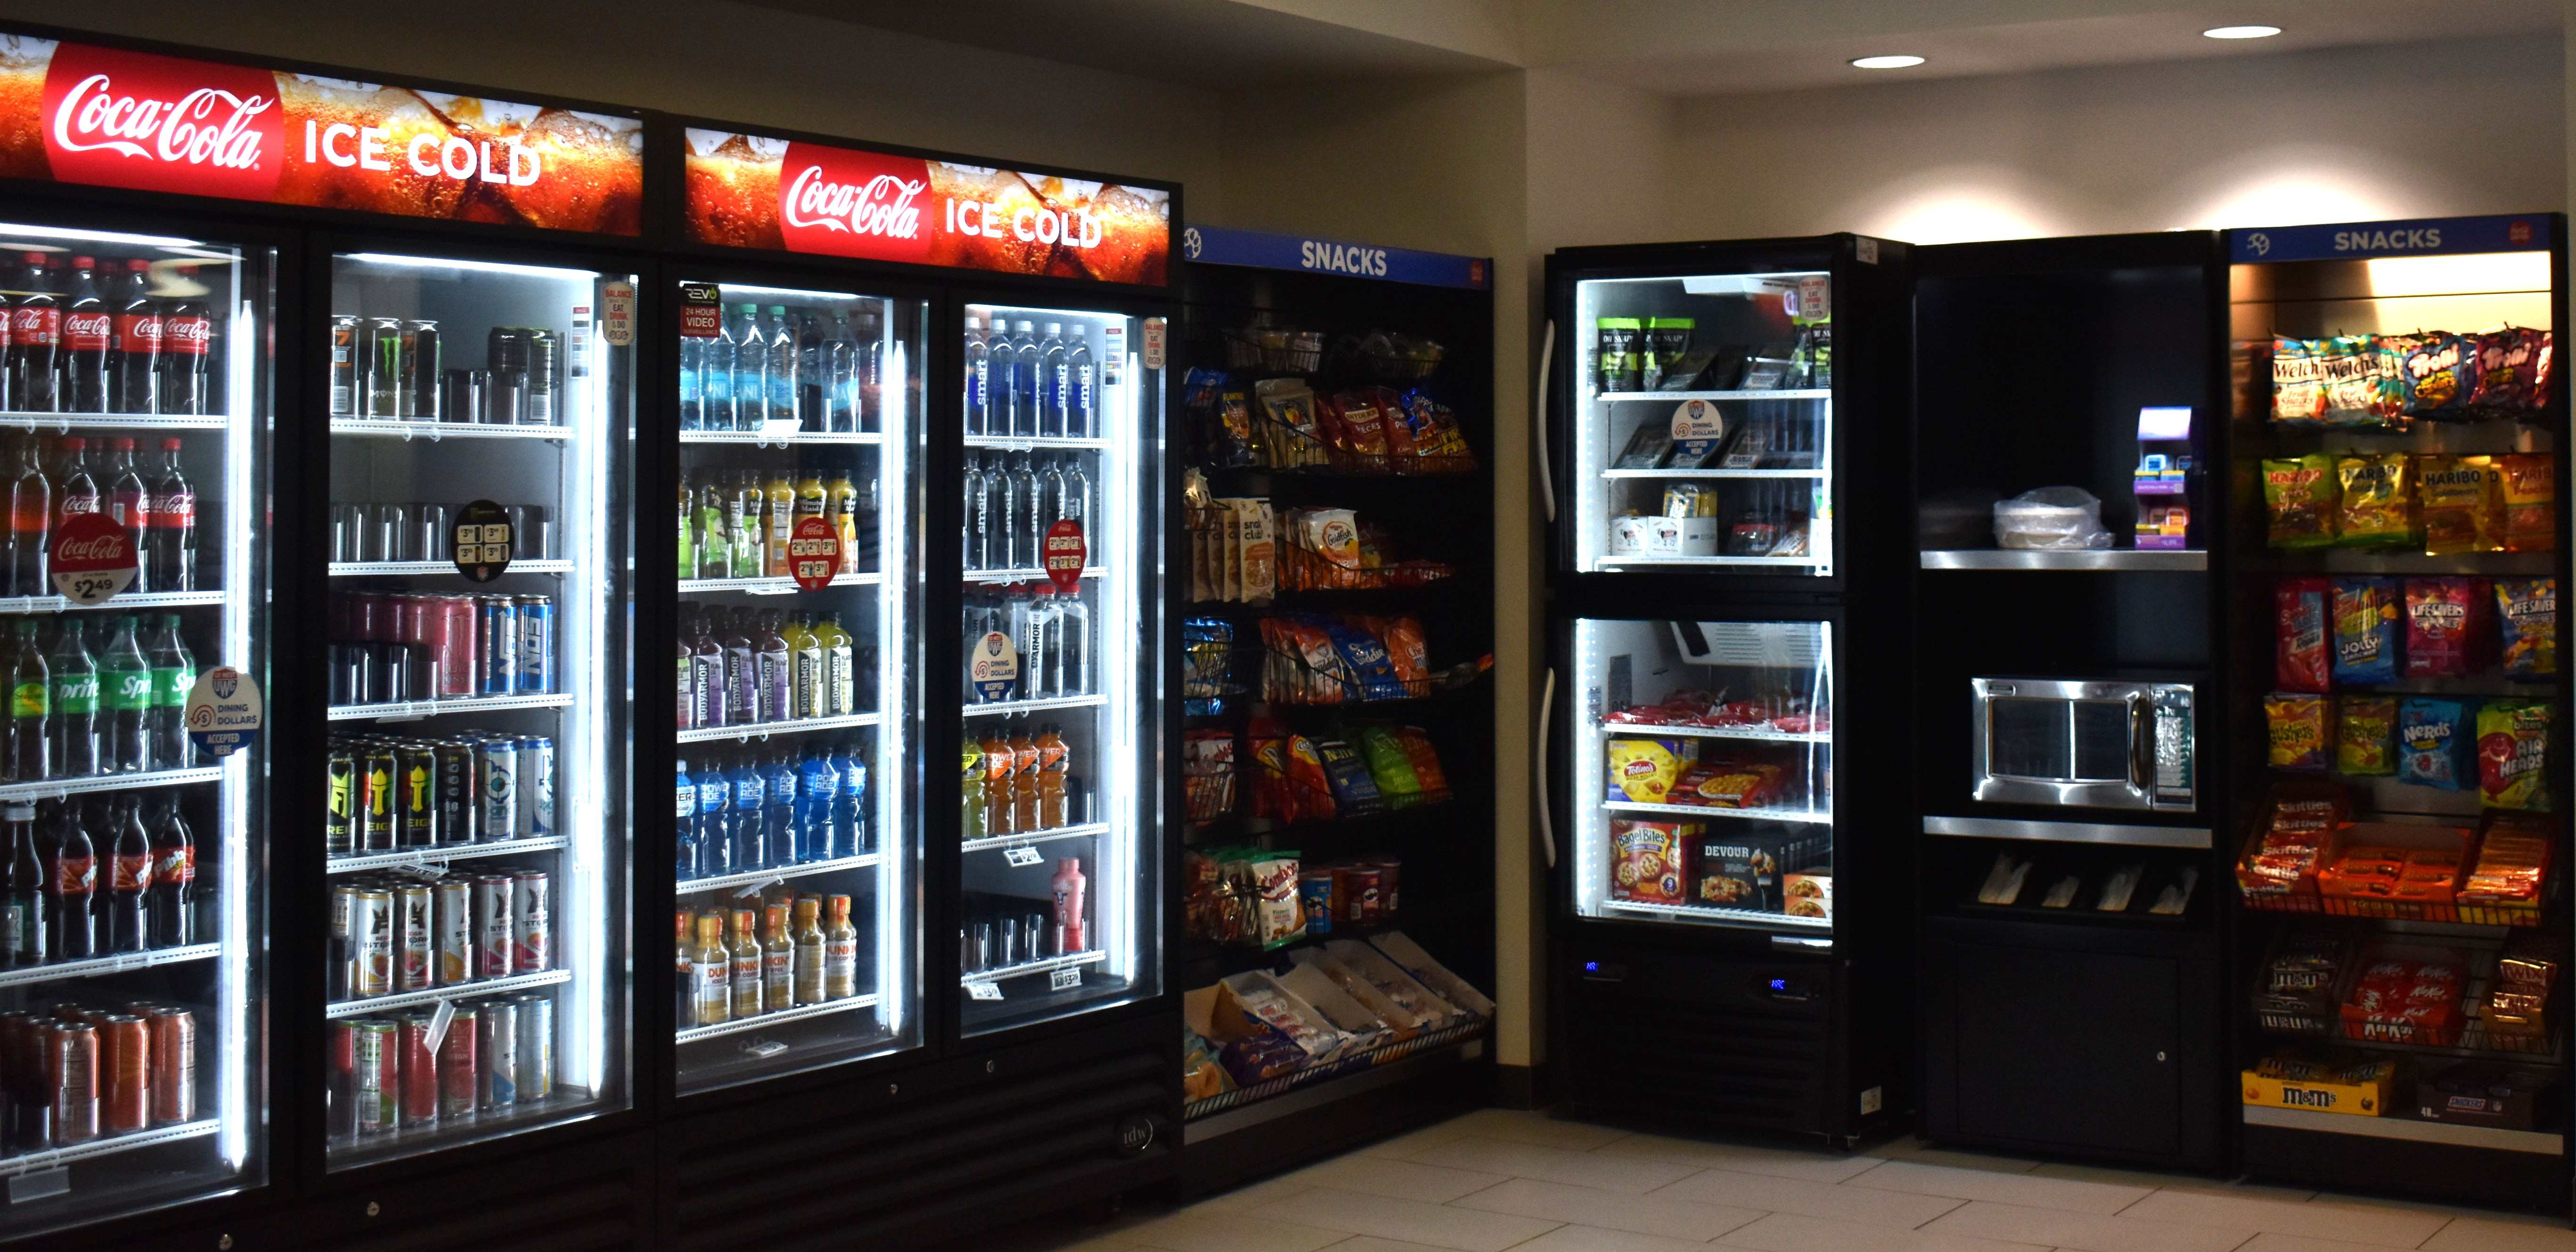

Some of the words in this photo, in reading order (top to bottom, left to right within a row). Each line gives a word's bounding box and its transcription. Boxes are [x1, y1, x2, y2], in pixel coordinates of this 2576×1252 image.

[54, 73, 275, 172] Coca-Cola
[305, 119, 391, 172] ICE
[408, 134, 541, 187] COLD
[785, 165, 928, 239] Coca-Cola
[946, 198, 1003, 238] ICE
[1013, 206, 1102, 248] COLD
[2334, 229, 2442, 251] SNACKS
[1301, 241, 1387, 277] SNACKS
[696, 308, 716, 316] HOUR
[686, 317, 715, 327] VIDEO
[1603, 335, 1612, 343] OH
[2408, 343, 2460, 377] Trolli
[2482, 343, 2532, 371] Trolli
[2274, 359, 2319, 377] Welch
[2326, 357, 2378, 377] Welch's
[976, 359, 987, 406] smart
[1058, 364, 1068, 409] smart
[1079, 364, 1091, 409] smart
[2425, 469, 2481, 486] HARIBO
[977, 491, 987, 533] smart
[1328, 529, 1353, 544] Goldfish
[58, 535, 124, 561] Coca-Cola
[2529, 599, 2555, 613] SAVER
[517, 616, 541, 675] NOS
[2341, 636, 2379, 655] JOLLY
[213, 680, 236, 697] UWG
[700, 663, 708, 721] BODYARMOR
[732, 656, 742, 712] BODYARMOR
[764, 661, 774, 717] BODYARMOR
[800, 658, 809, 713] BODYARMOR
[832, 655, 840, 710] BODYARMOR
[218, 704, 248, 713] DINING
[218, 715, 257, 725] DOLLARS
[207, 733, 240, 743] ACCEPTED
[2516, 739, 2543, 754] AIR
[1626, 763, 1653, 776] Totino's
[2500, 754, 2543, 777] HEADS
[2278, 801, 2332, 812] Skittles
[1617, 831, 1642, 846] Bagel
[1643, 829, 1665, 844] Bites
[1705, 845, 1749, 858] DEVOUR
[2253, 864, 2300, 880] Skittle
[1667, 879, 1673, 888] 9
[2449, 1096, 2486, 1110] SNICKERS
